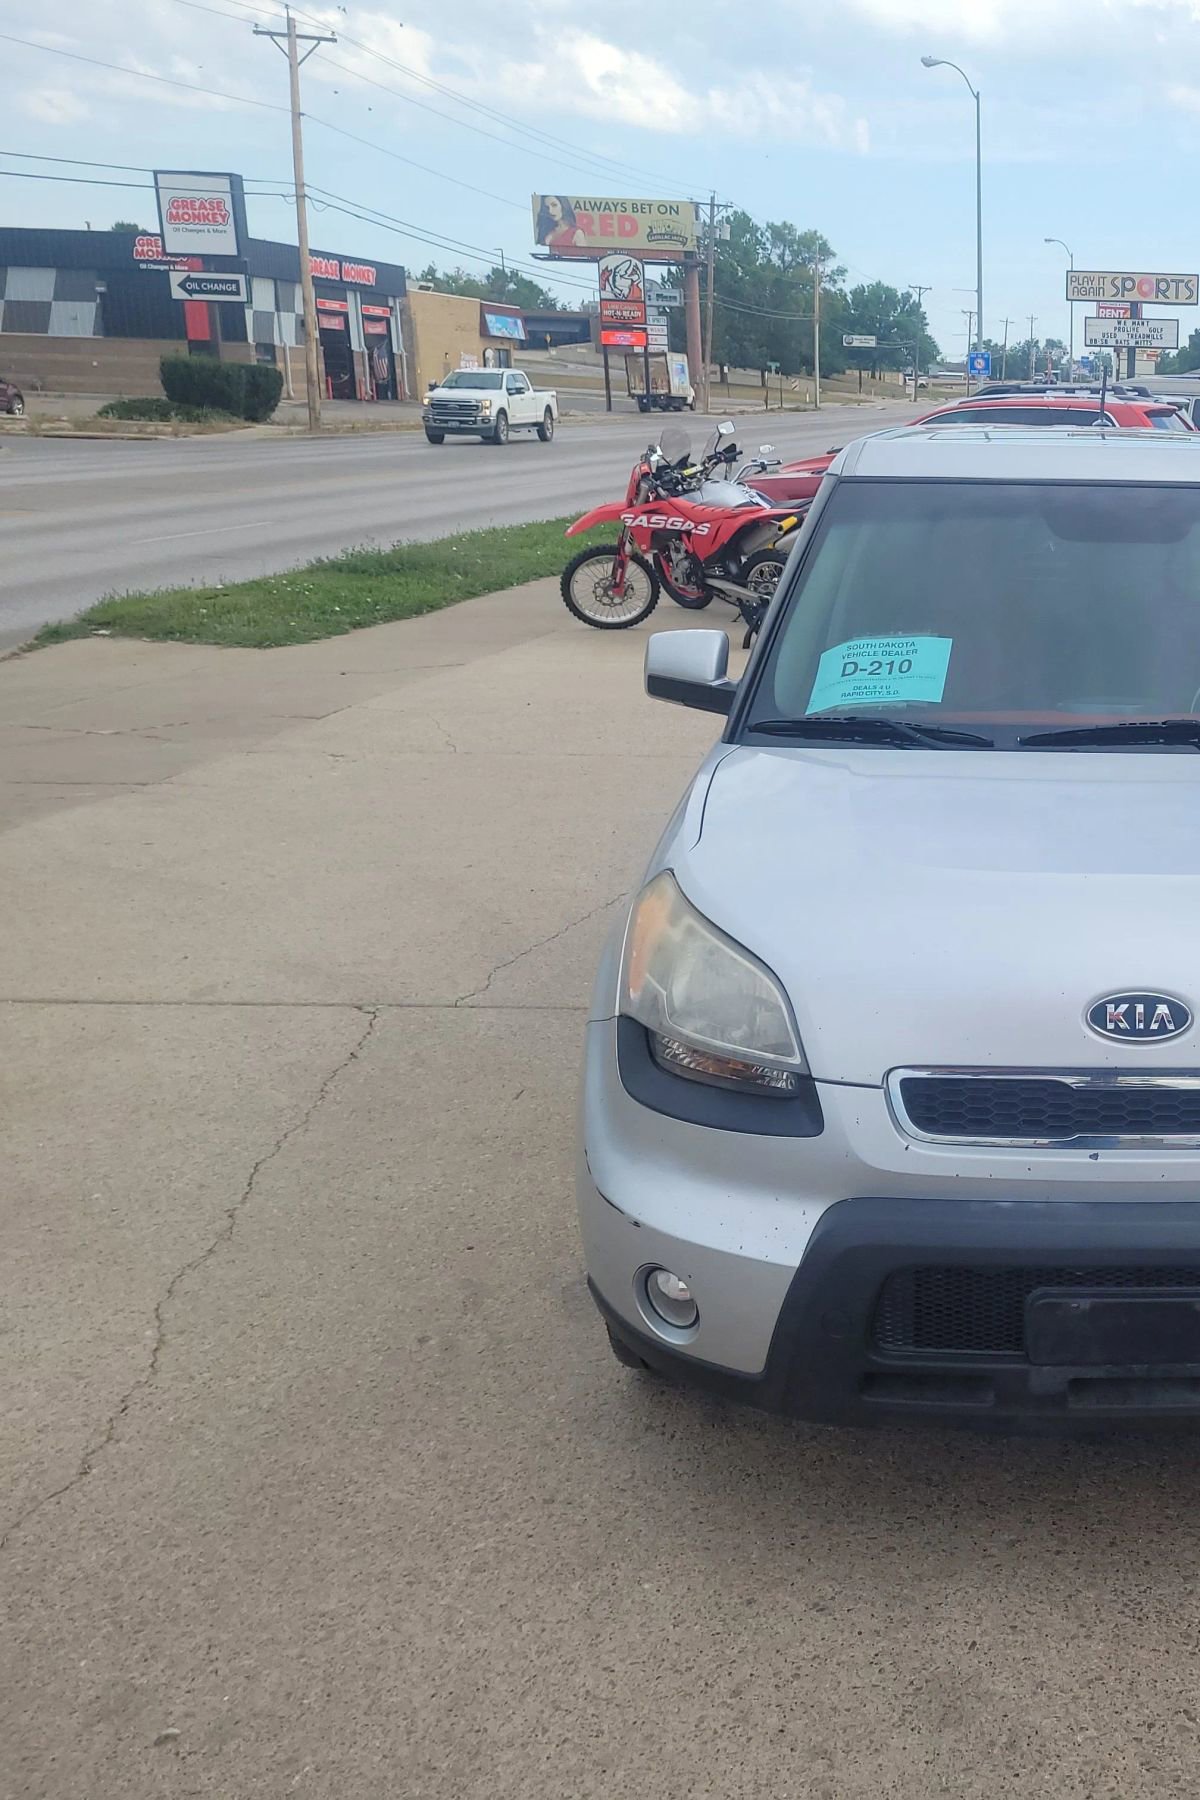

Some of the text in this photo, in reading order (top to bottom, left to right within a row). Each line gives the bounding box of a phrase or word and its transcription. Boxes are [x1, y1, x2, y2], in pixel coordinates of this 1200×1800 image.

[170, 198, 224, 212] GREASE
[574, 200, 680, 215] ALWAYS BET ON
[168, 211, 228, 224] MONKEY
[576, 213, 638, 238] RED
[137, 237, 161, 248] GRE
[134, 247, 163, 258] MON
[342, 262, 376, 286] MONKEY
[1070, 275, 1107, 286] PLAY IT
[186, 282, 237, 292] OIL CHANGE
[1072, 286, 1105, 297] AGAIN
[1111, 276, 1194, 300] SPORTS
[1099, 308, 1125, 318] RENT
[620, 513, 711, 536] GASGAS
[846, 641, 916, 651] SOUTH DAKOTA
[842, 648, 918, 660] VEHICLE DEALER
[840, 659, 913, 678] D-210
[1105, 1003, 1175, 1030] KIA
